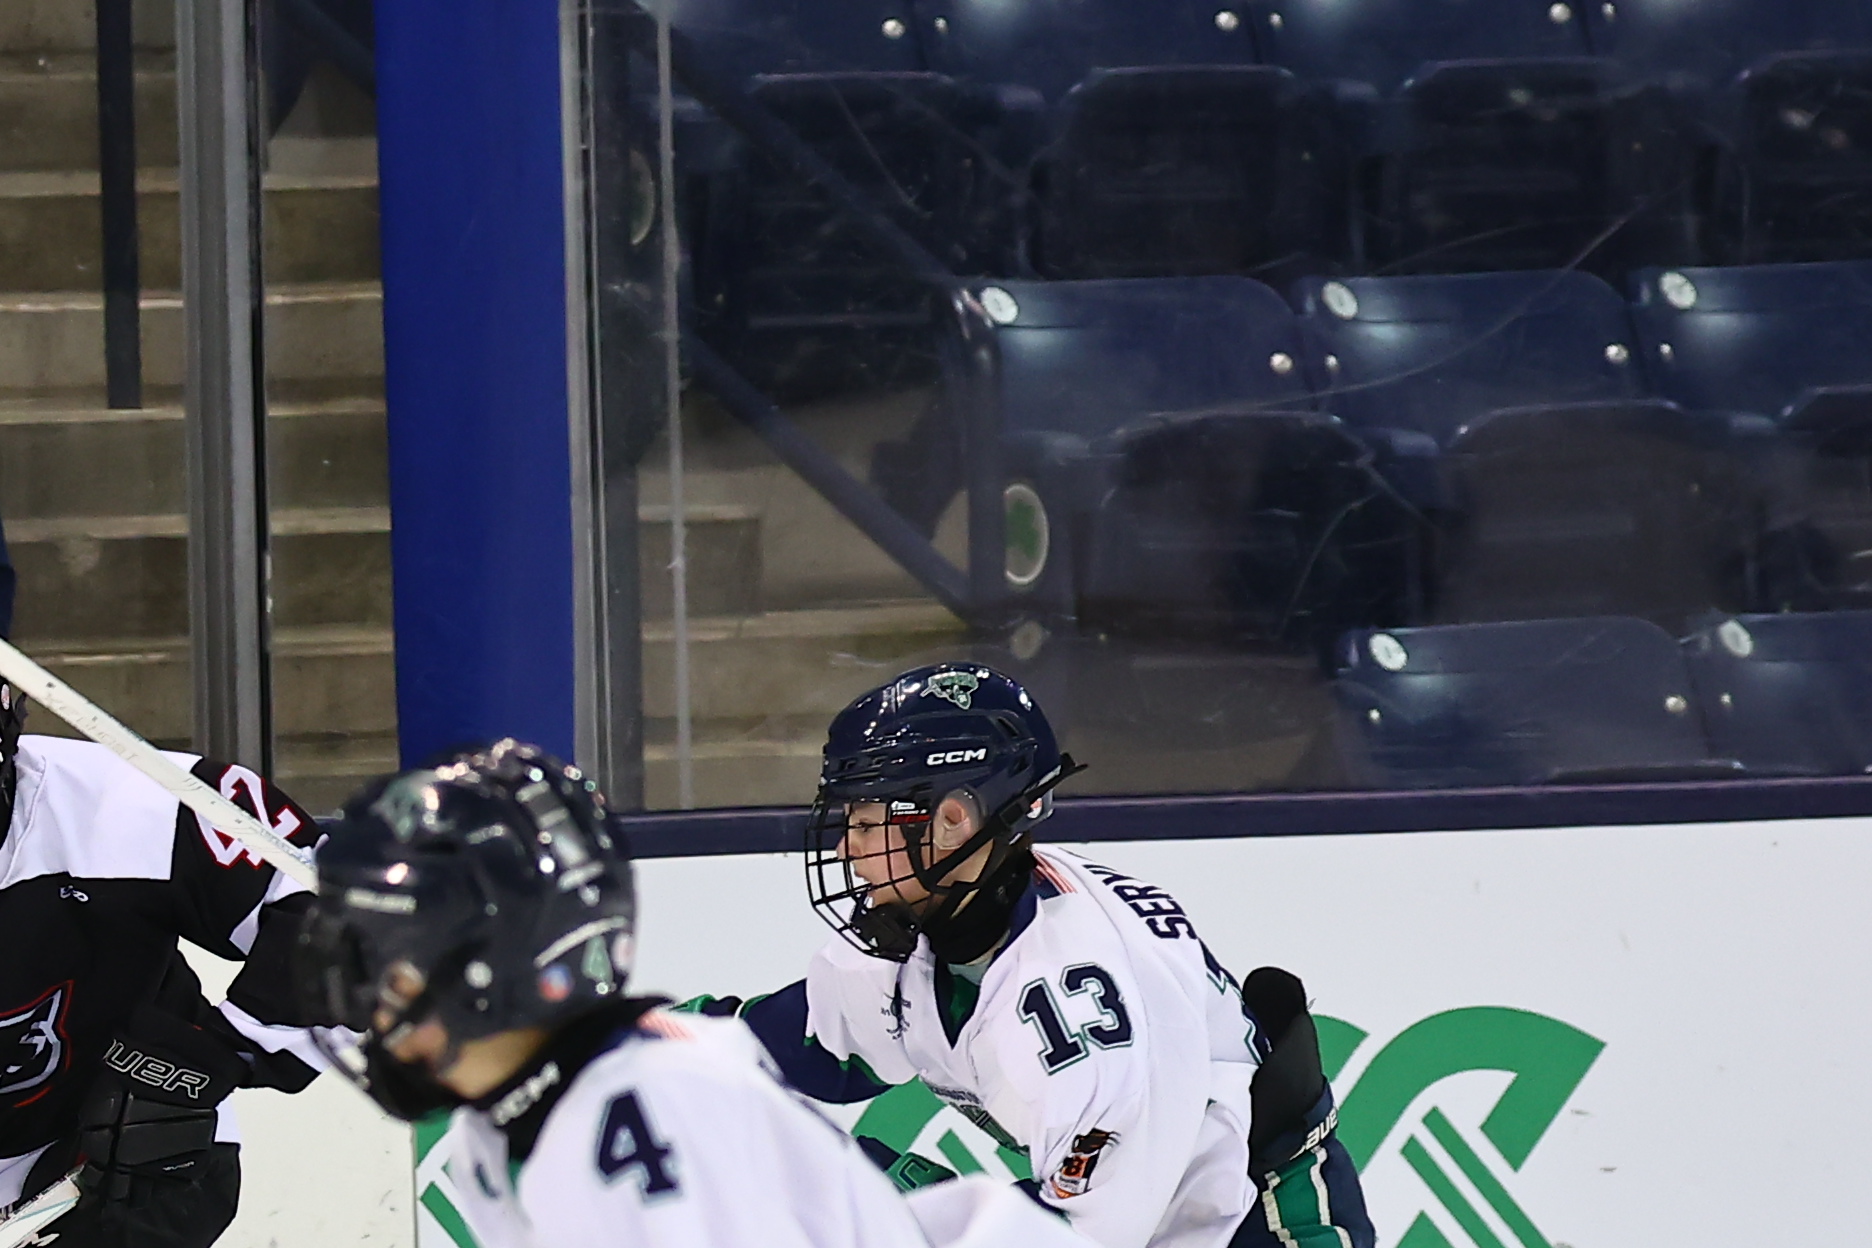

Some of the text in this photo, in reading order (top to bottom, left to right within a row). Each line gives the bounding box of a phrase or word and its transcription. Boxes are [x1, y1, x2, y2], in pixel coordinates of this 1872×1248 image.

[925, 748, 987, 766] CCM
[1016, 961, 1135, 1077] 13
[102, 1037, 211, 1100] UER
[593, 1088, 684, 1210] 4
